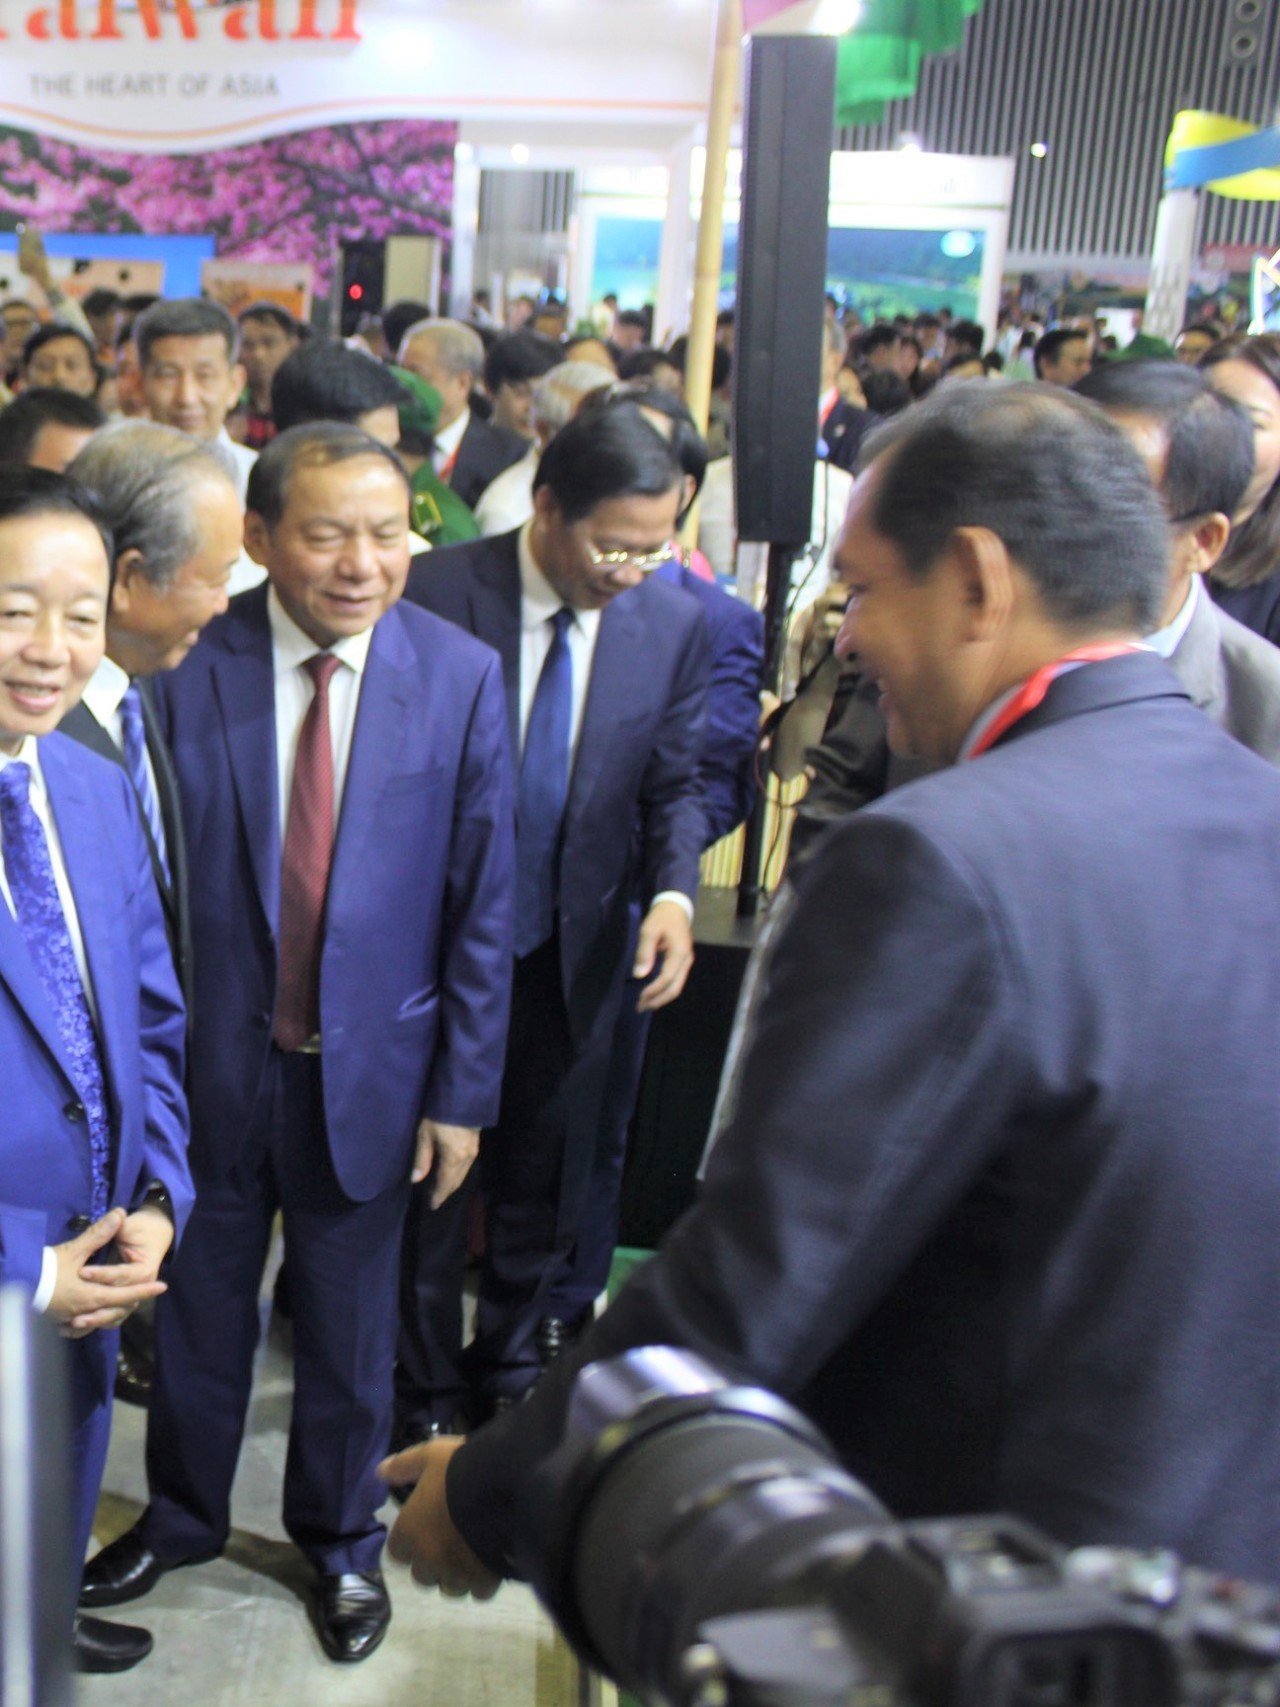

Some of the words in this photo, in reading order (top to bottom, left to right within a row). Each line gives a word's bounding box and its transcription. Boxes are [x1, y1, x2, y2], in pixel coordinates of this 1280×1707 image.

[30, 73, 76, 98] THE
[86, 73, 168, 98] HEART
[179, 73, 211, 97] OF
[220, 73, 280, 97] ASIA
